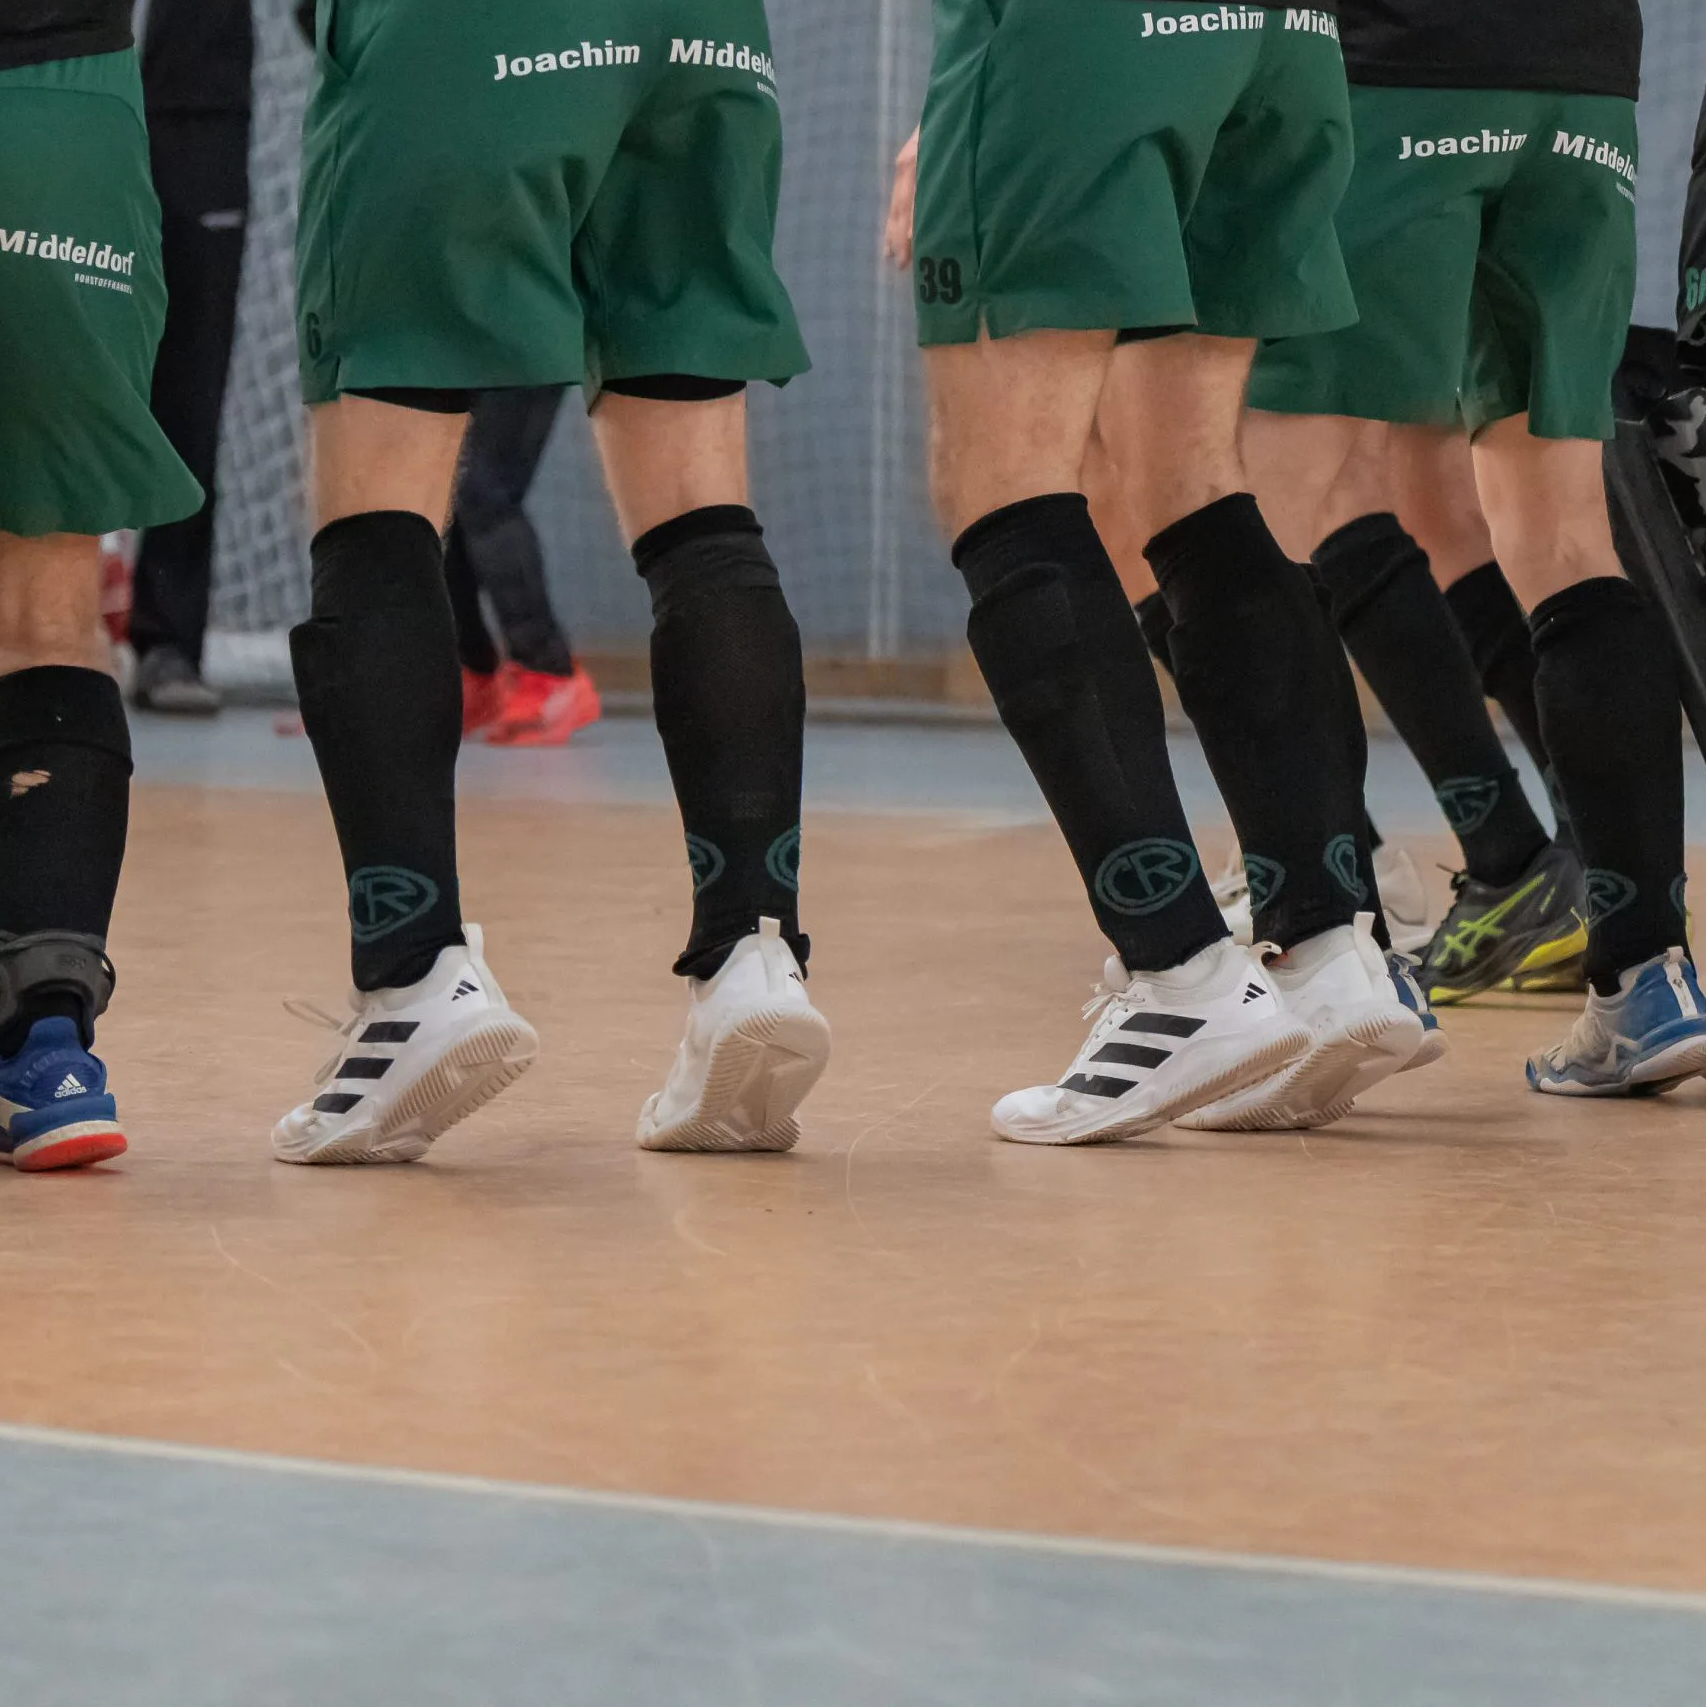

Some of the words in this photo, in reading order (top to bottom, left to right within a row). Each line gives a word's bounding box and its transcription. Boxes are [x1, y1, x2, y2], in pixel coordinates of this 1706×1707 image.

[1141, 5, 1264, 38] Joachim
[493, 39, 641, 82] Joachim
[1398, 128, 1528, 160] Joachim
[919, 256, 963, 305] 39
[54, 1085, 87, 1098] adidas
